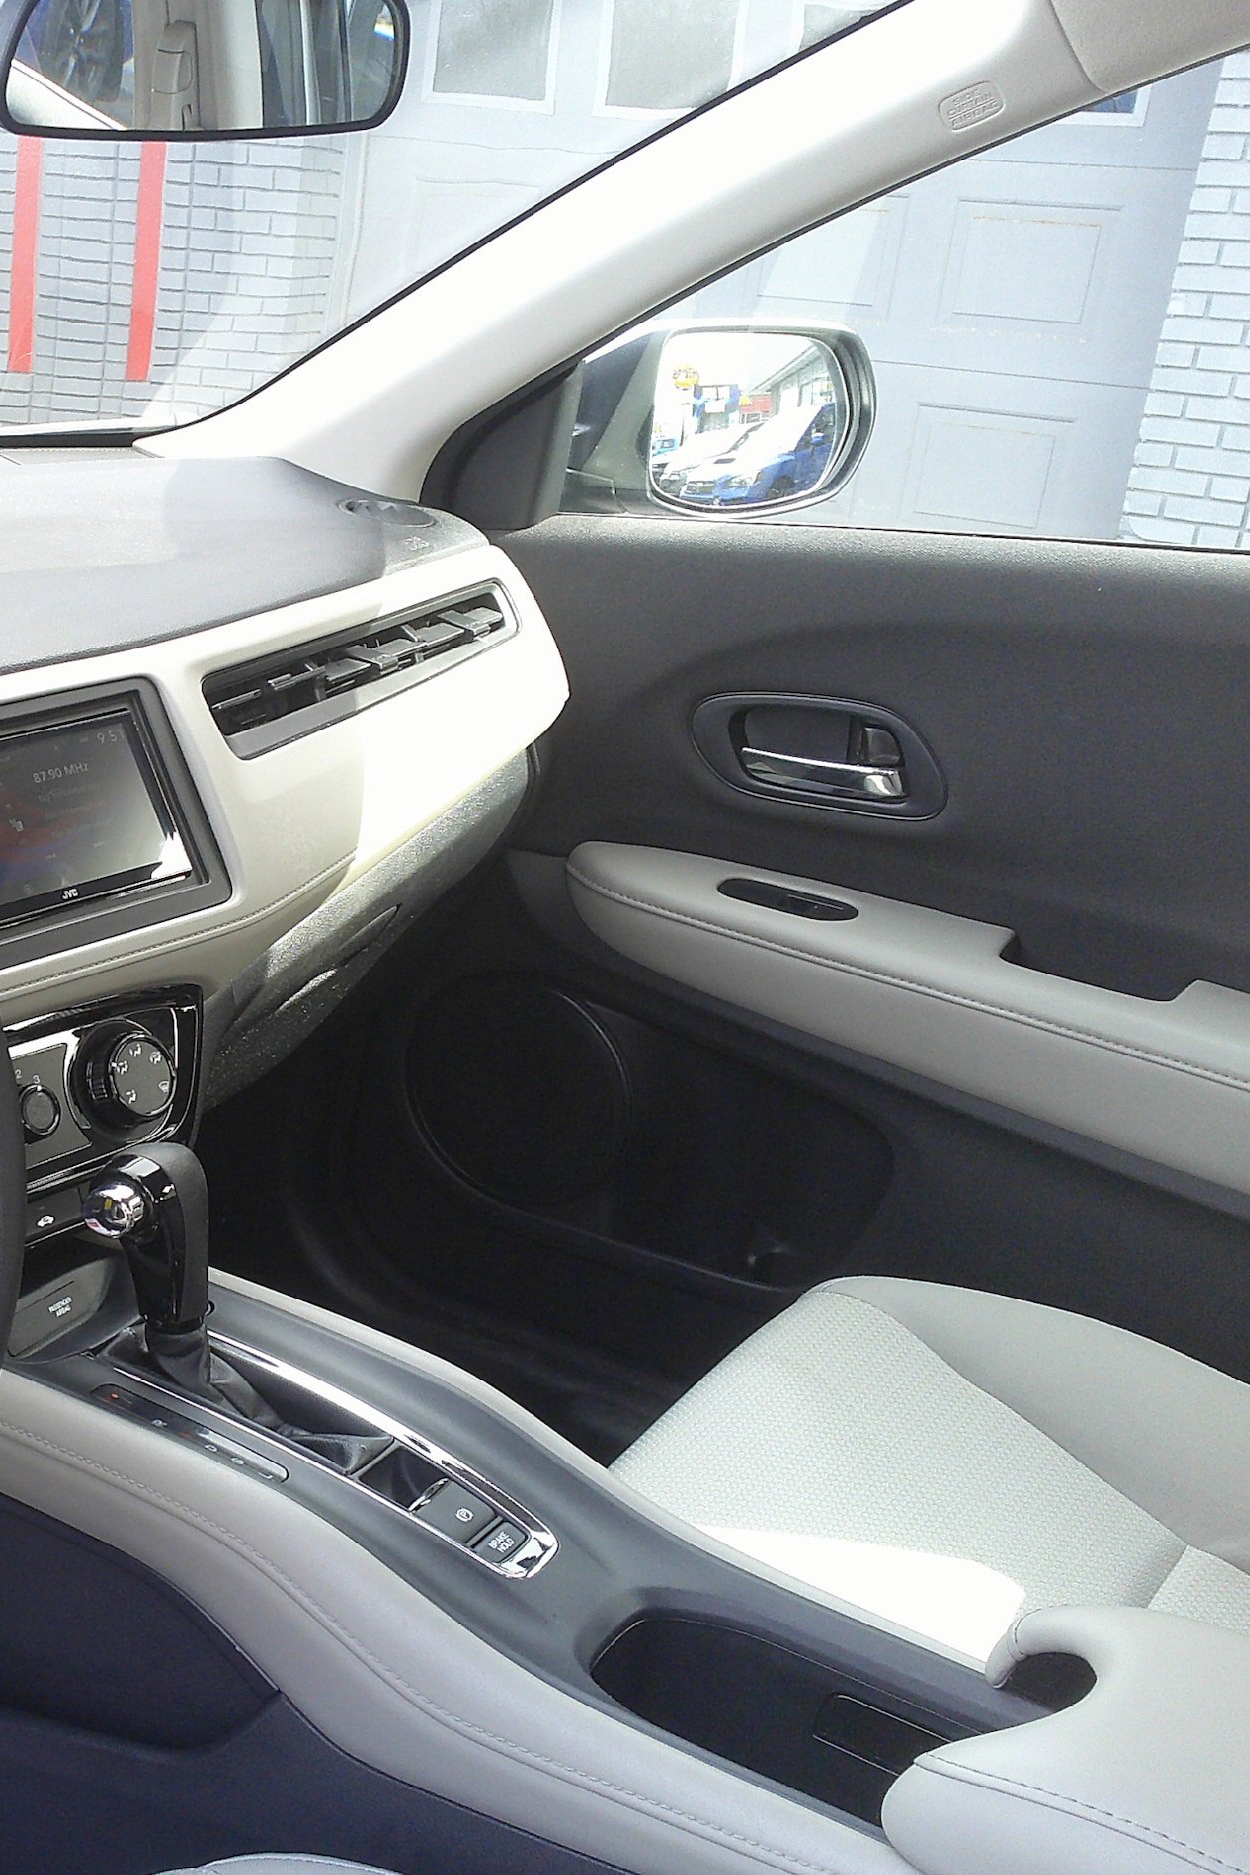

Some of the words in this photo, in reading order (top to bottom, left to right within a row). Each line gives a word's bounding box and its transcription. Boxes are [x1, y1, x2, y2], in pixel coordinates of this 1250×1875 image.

[63, 761, 90, 777] MHz
[62, 888, 79, 900] JVC
[32, 1074, 41, 1084] 3
[488, 1531, 509, 1549] BRAKE
[497, 1538, 515, 1553] HOLD
